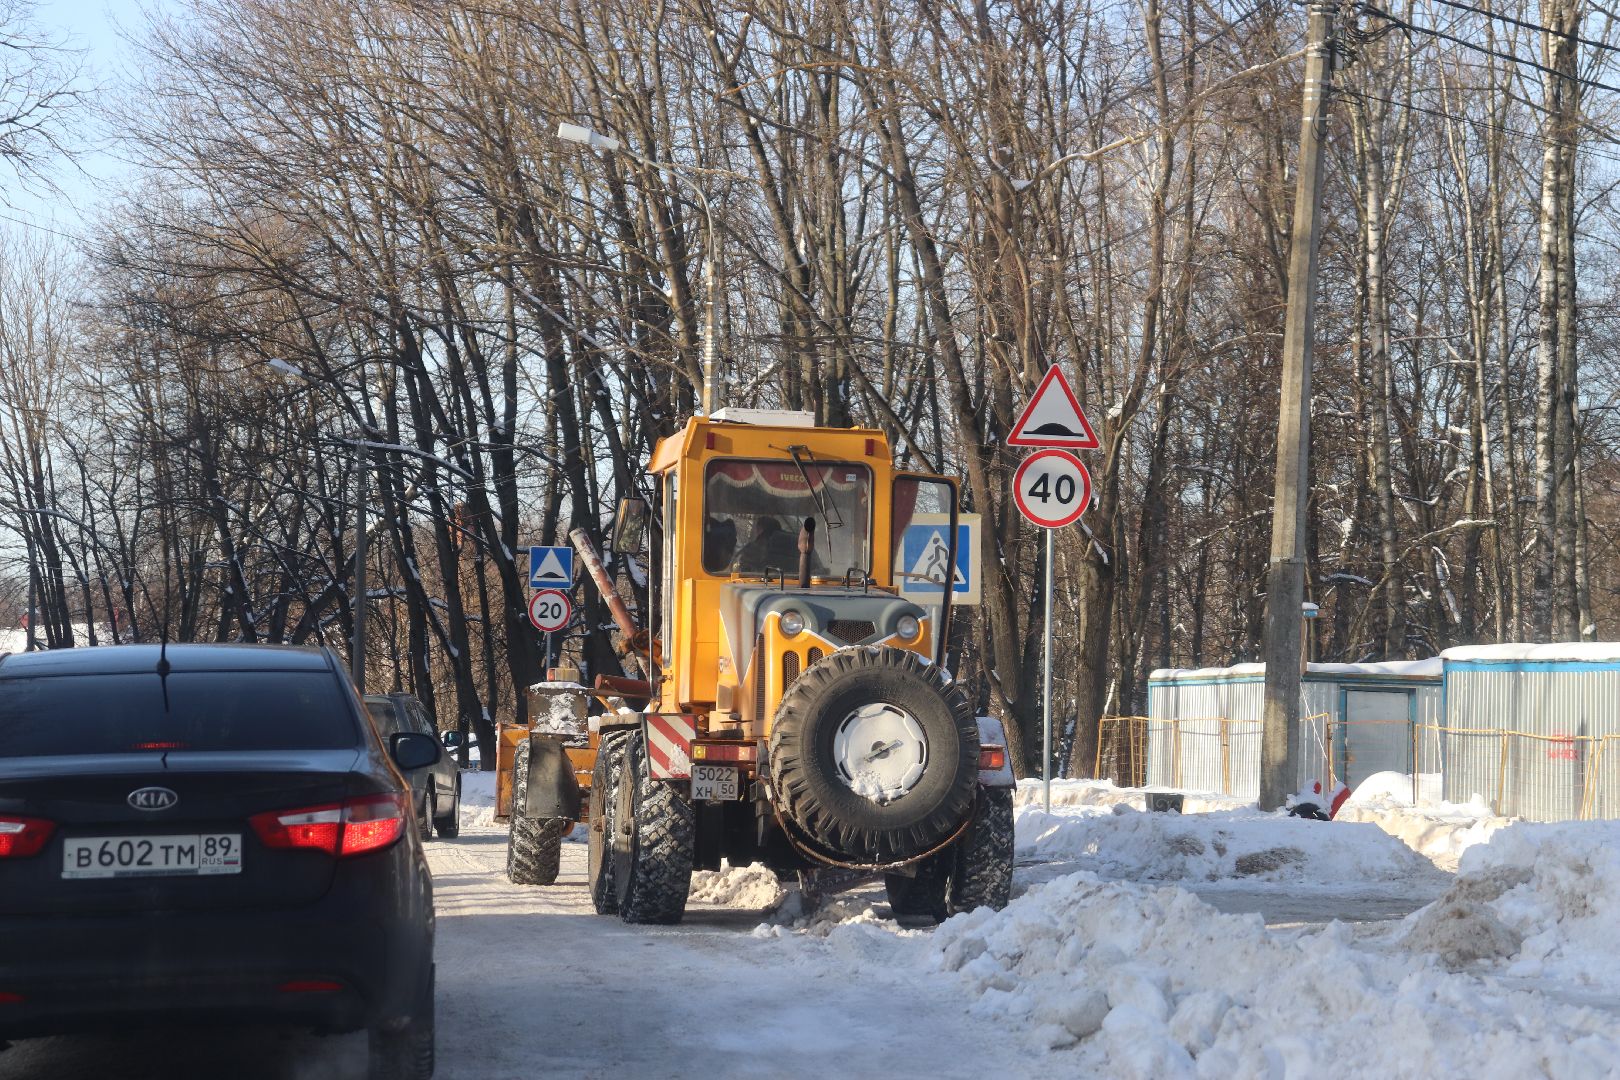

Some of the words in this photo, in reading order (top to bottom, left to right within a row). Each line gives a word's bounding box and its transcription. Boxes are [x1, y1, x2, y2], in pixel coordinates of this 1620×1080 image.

[780, 473, 805, 483] IVECO
[1028, 472, 1076, 505] 40
[538, 601, 562, 619] 20
[698, 767, 733, 781] 5022
[720, 783, 735, 795] 50
[136, 792, 170, 806] KIA
[204, 836, 233, 857] 89
[201, 857, 223, 865] RUS
